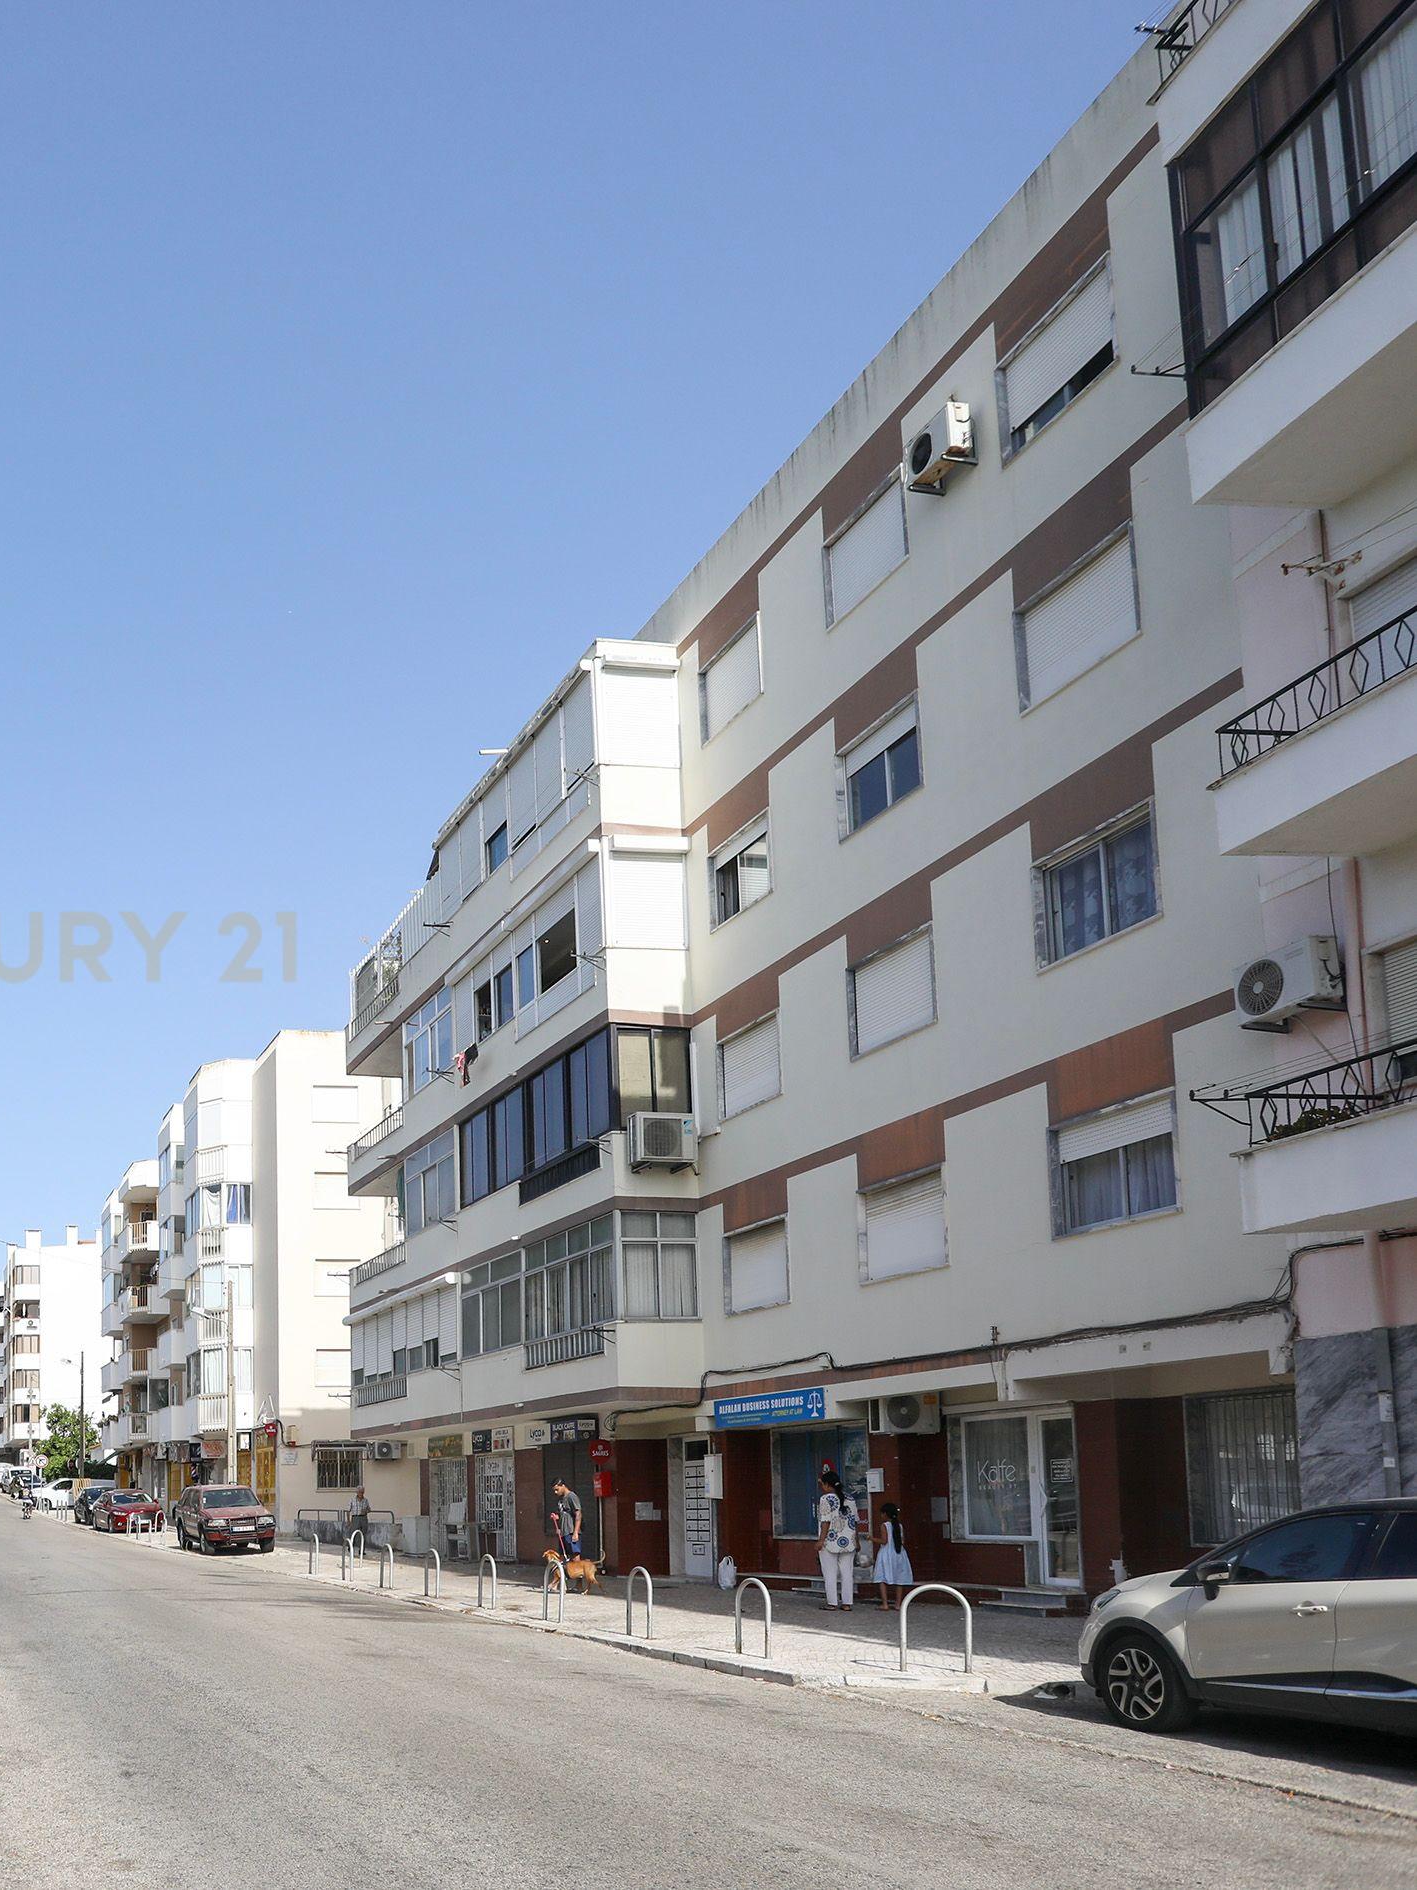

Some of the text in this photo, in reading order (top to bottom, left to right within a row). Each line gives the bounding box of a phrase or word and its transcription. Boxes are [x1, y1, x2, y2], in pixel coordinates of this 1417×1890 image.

[719, 1396, 804, 1415] ALFALAH BUSINESS SOLUTIONS
